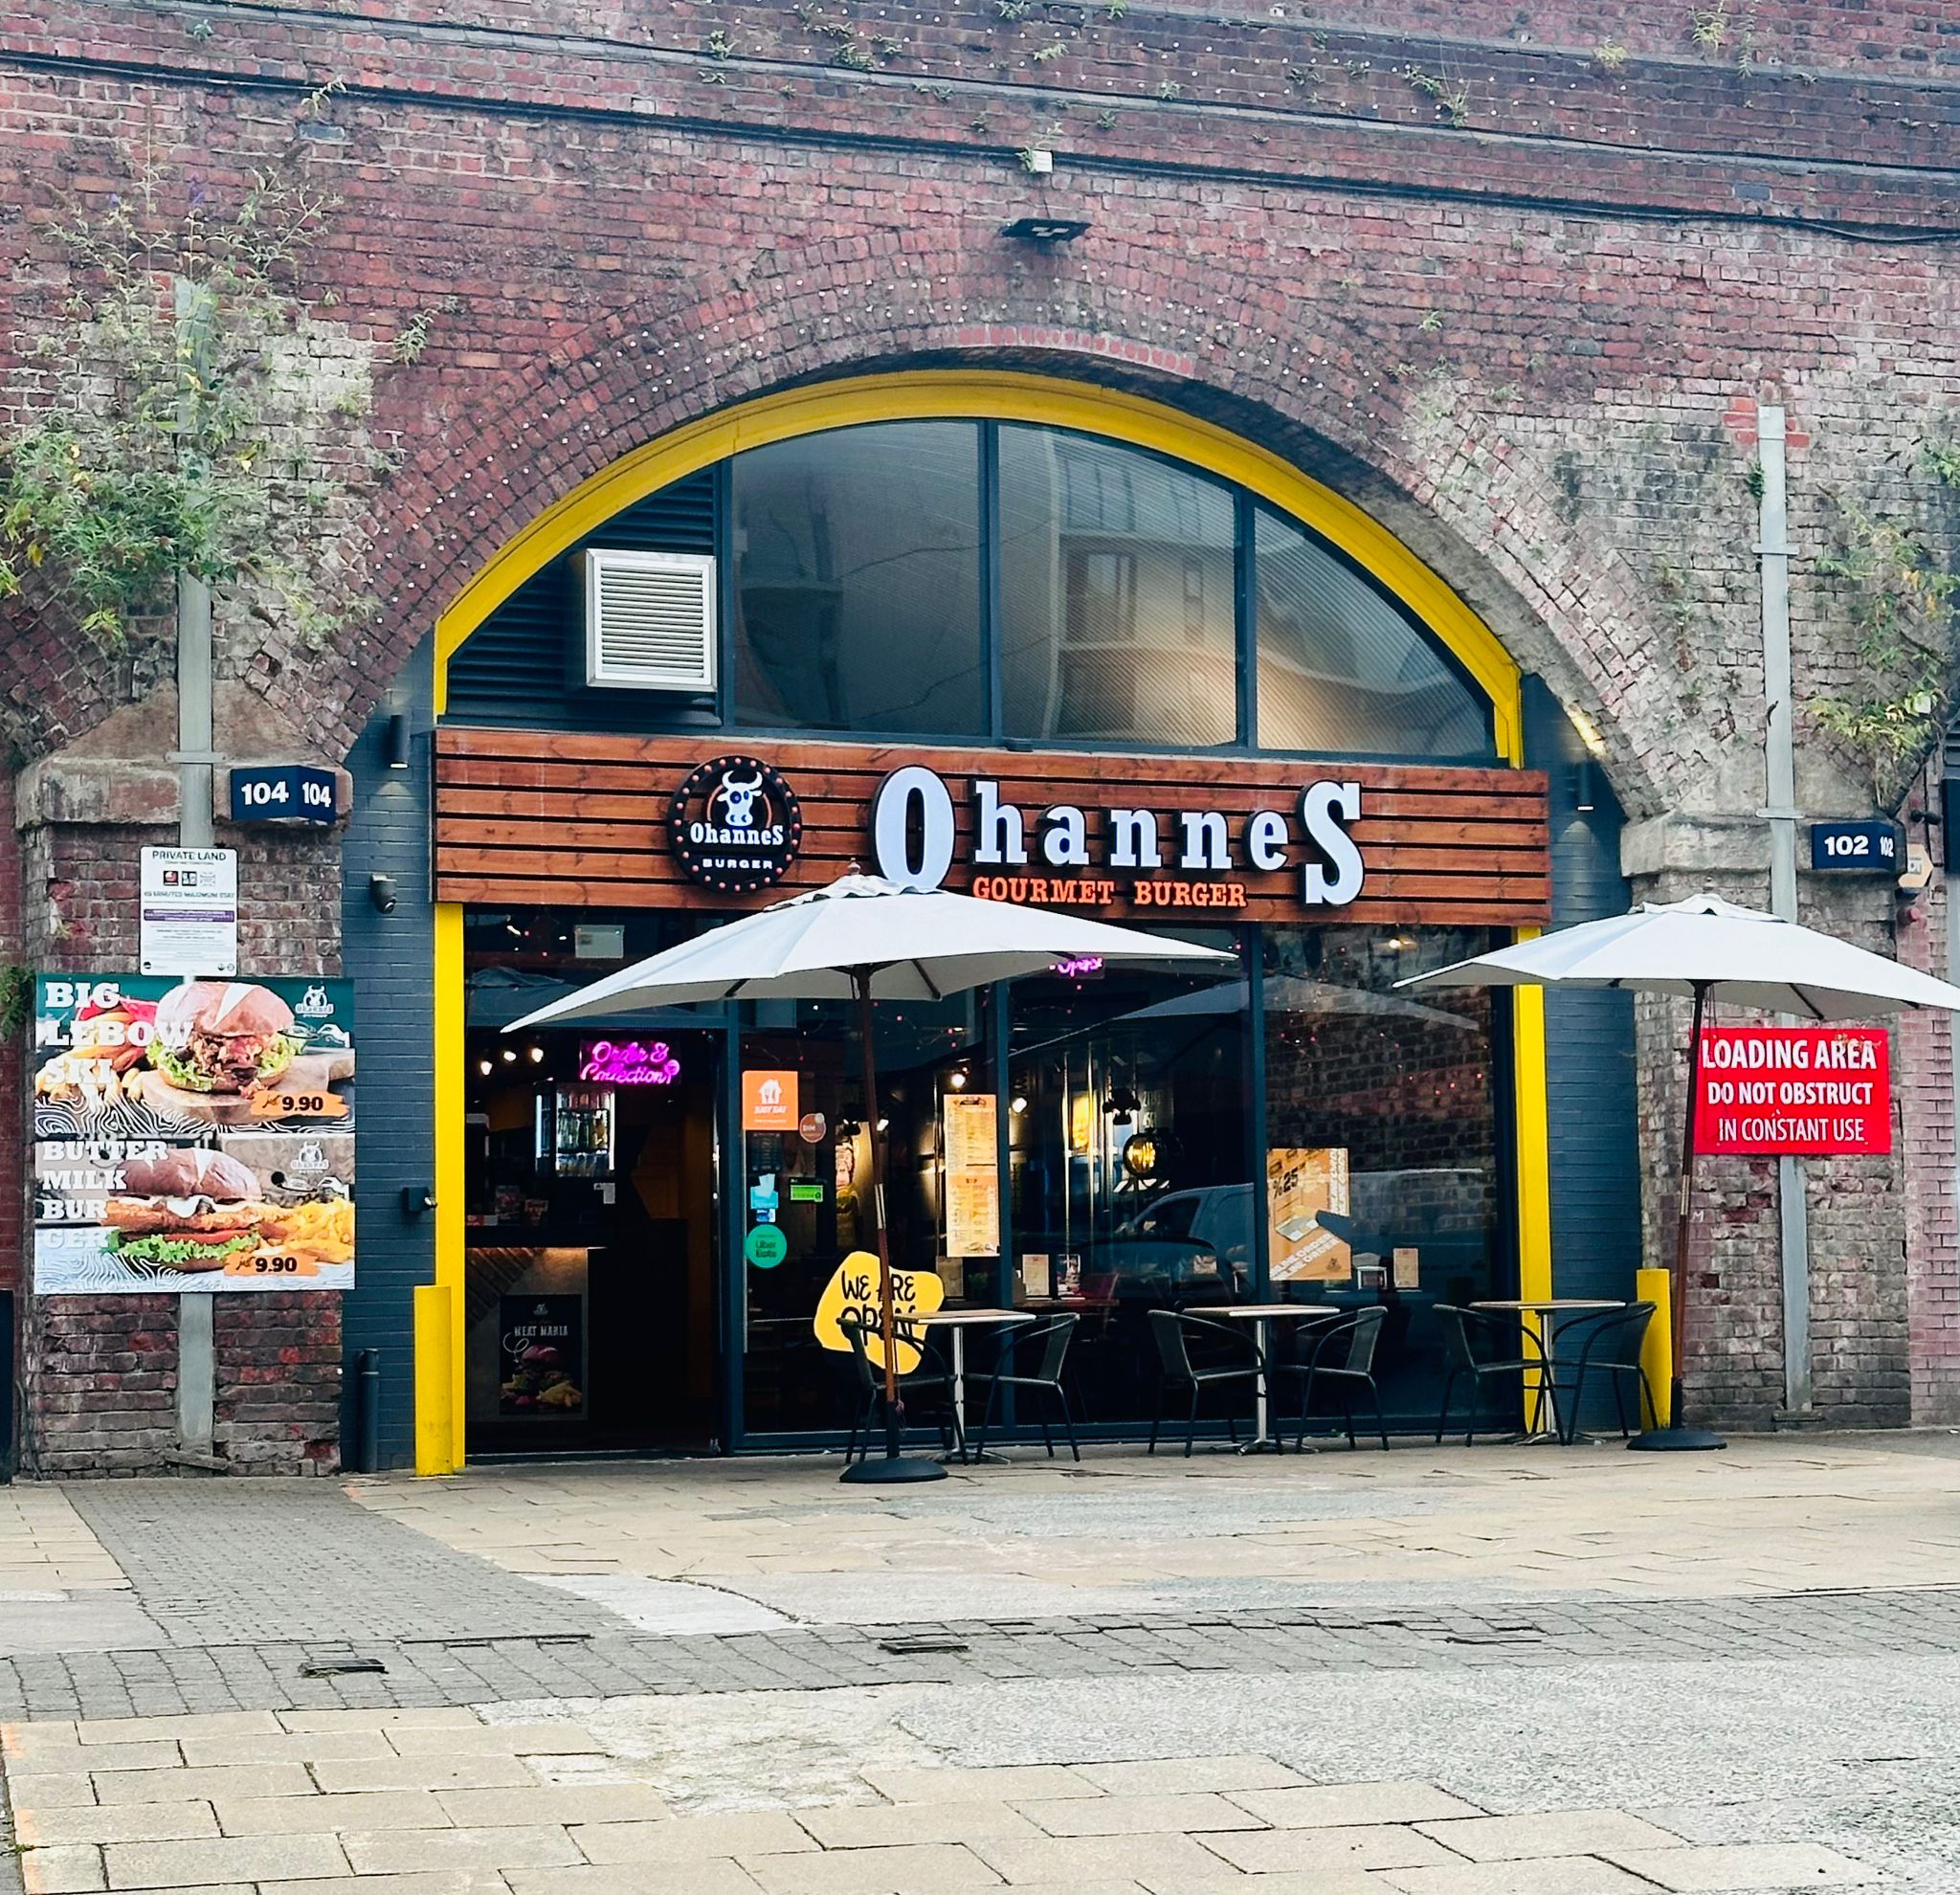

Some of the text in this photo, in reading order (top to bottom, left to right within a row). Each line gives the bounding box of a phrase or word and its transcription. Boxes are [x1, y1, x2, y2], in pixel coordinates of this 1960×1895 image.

[241, 781, 289, 805] 104
[301, 782, 332, 807] 104
[690, 822, 784, 846] OhanneS
[875, 766, 1365, 906] OhanneS
[1824, 836, 1869, 856] 102
[152, 851, 227, 861] PRIVATE LAND
[1879, 836, 1895, 858] 102
[702, 858, 774, 869] BURGER
[972, 878, 1248, 908] GOURMET BURGER
[45, 982, 120, 1009] BIG
[45, 1019, 195, 1047] LEBOW
[1702, 1039, 1877, 1070] LOADING AREA
[46, 1058, 113, 1084] SKI
[281, 1096, 323, 1111] 9.90
[1707, 1081, 1873, 1105] DO NOT OBSTRUCT
[1719, 1117, 1864, 1142] IN CONSTANT USE
[42, 1141, 168, 1161] BUTTER
[42, 1170, 127, 1190] MILK
[42, 1199, 108, 1219] BUR
[255, 1257, 297, 1272] 9.90
[841, 1271, 871, 1302] WE
